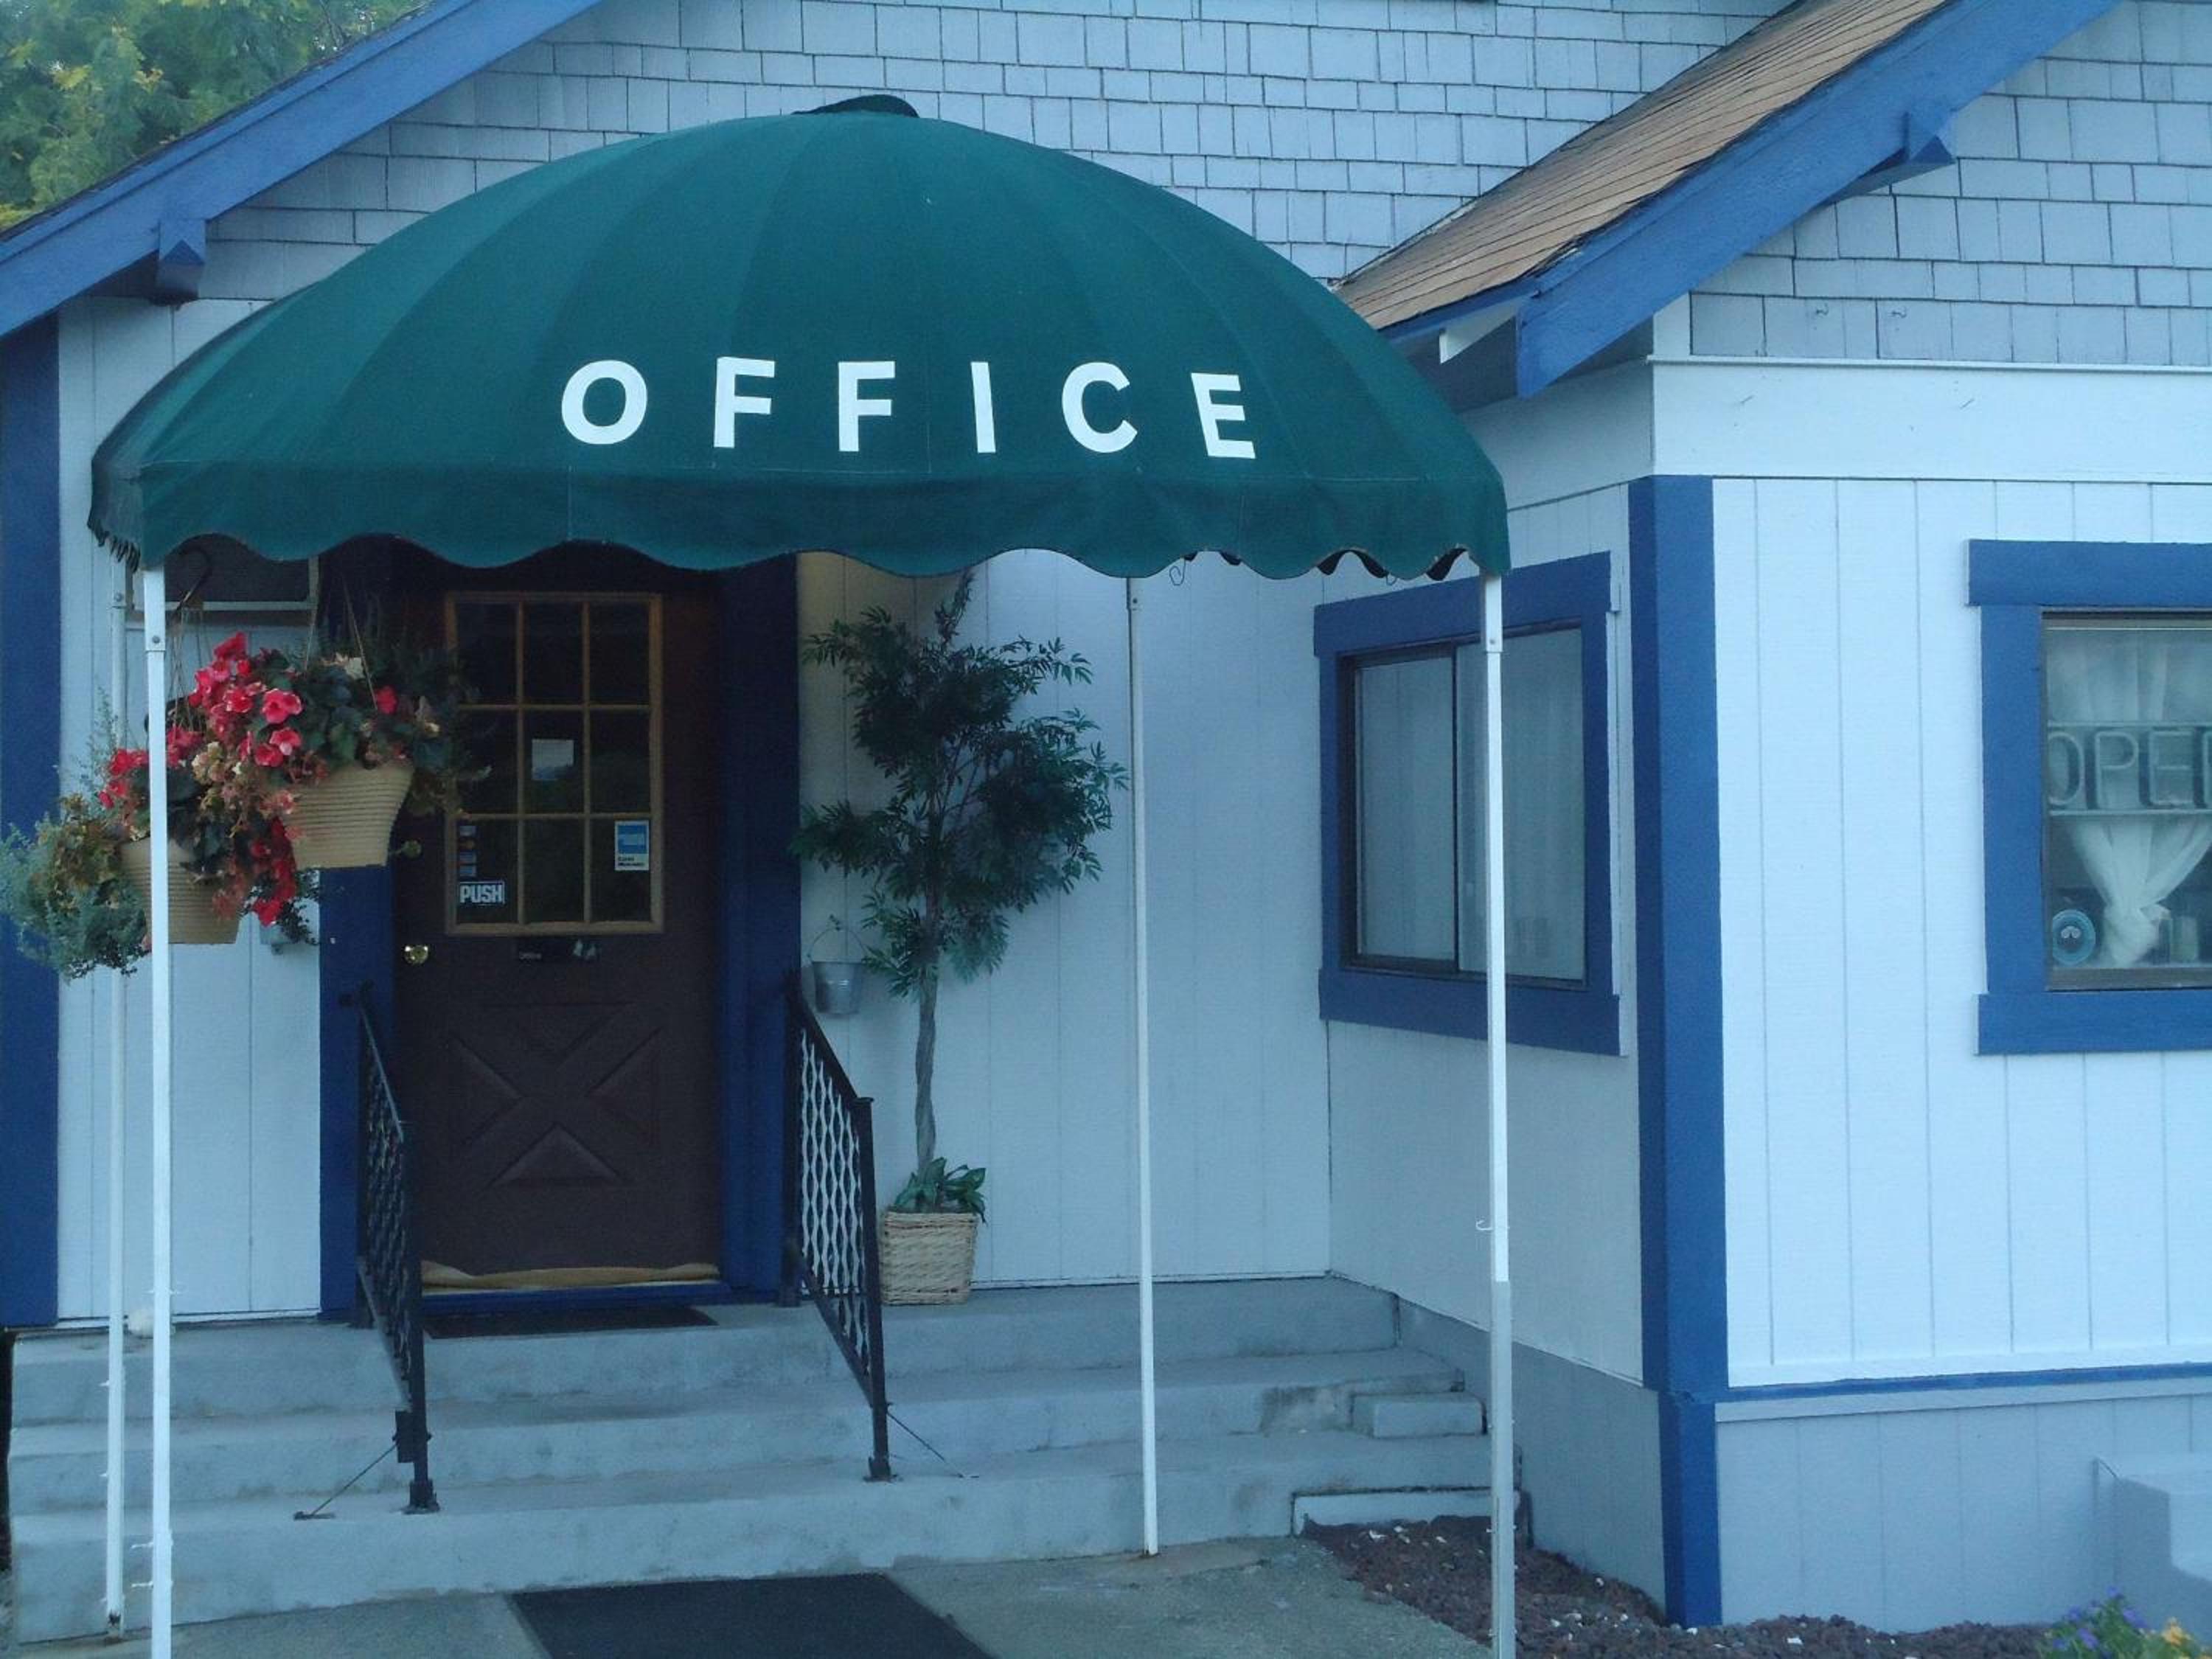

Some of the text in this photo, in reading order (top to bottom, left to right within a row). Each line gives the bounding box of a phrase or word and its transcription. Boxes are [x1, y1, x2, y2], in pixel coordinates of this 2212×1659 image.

[561, 357, 1256, 459] OFFICE
[2048, 731, 2212, 808] OPE
[460, 884, 502, 904] PUSH
